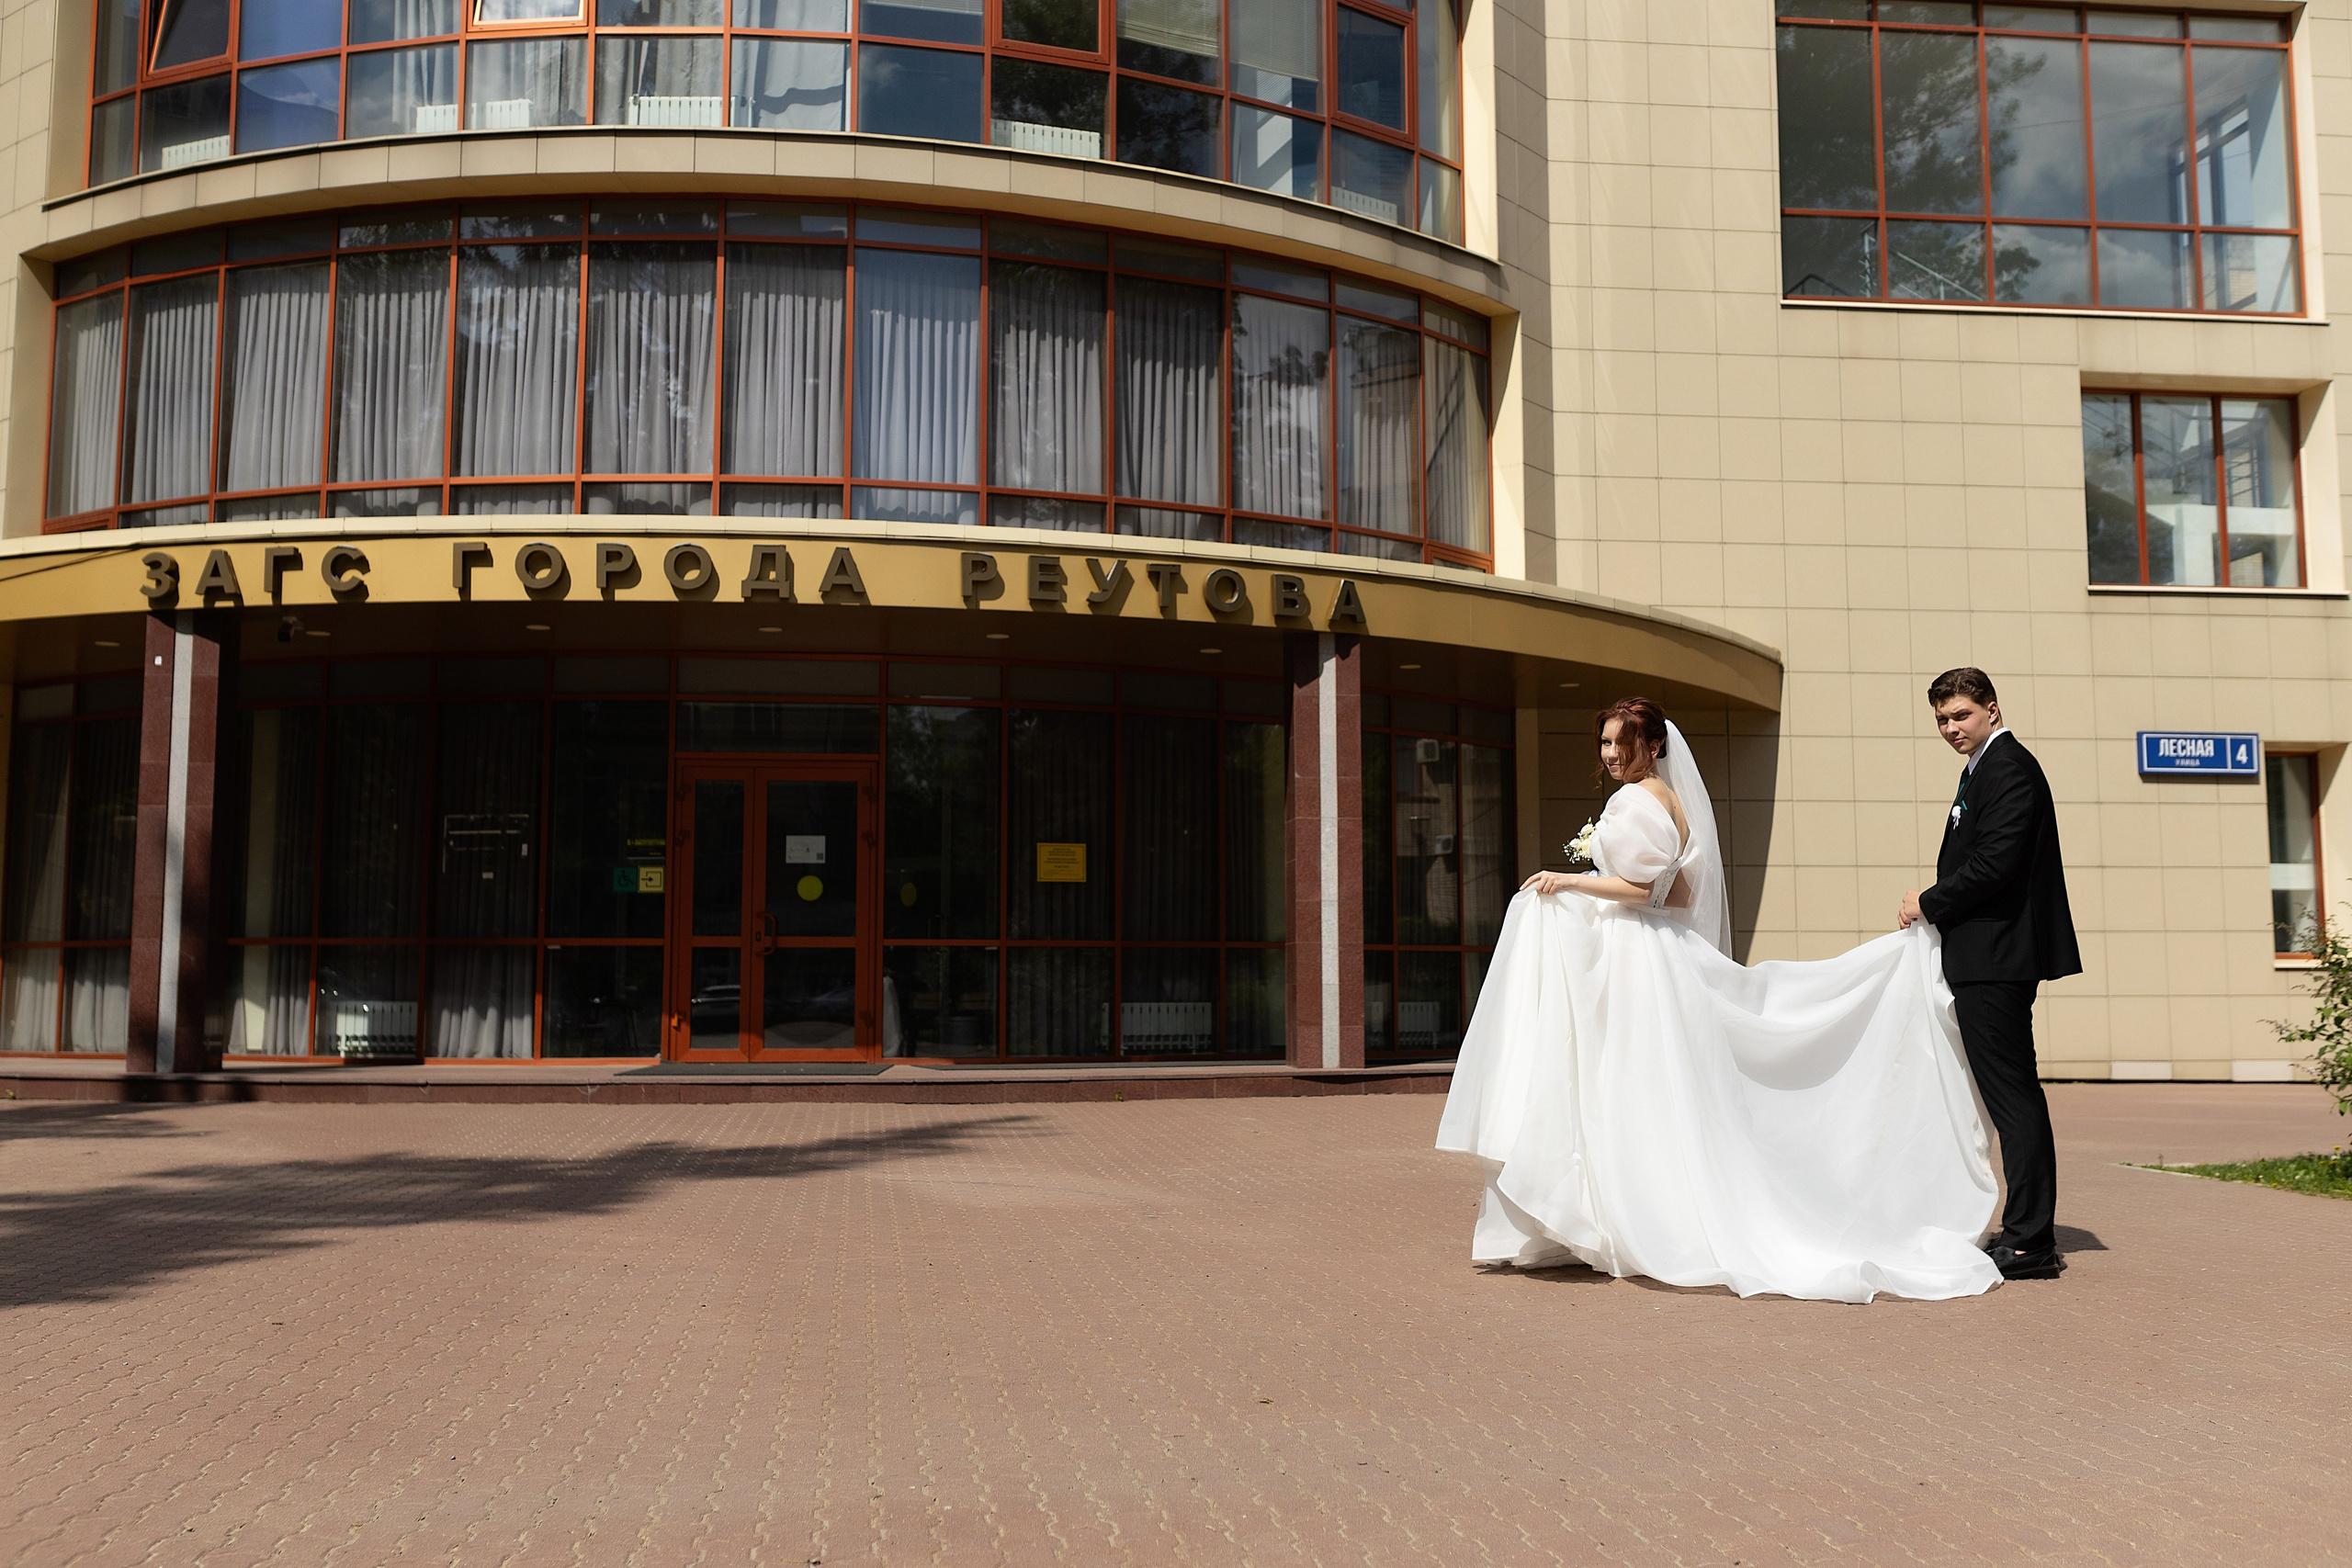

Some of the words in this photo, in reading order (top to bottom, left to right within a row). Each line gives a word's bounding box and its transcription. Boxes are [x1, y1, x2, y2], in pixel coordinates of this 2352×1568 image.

[140, 545, 371, 599] ЗАГС
[452, 541, 865, 599] ГОРОДА
[961, 551, 1366, 624] РЕУТОВА
[2158, 738, 2214, 758] ЛЕСНАЯ
[2235, 743, 2249, 764] 4
[2175, 758, 2200, 767] УЛИЦА
